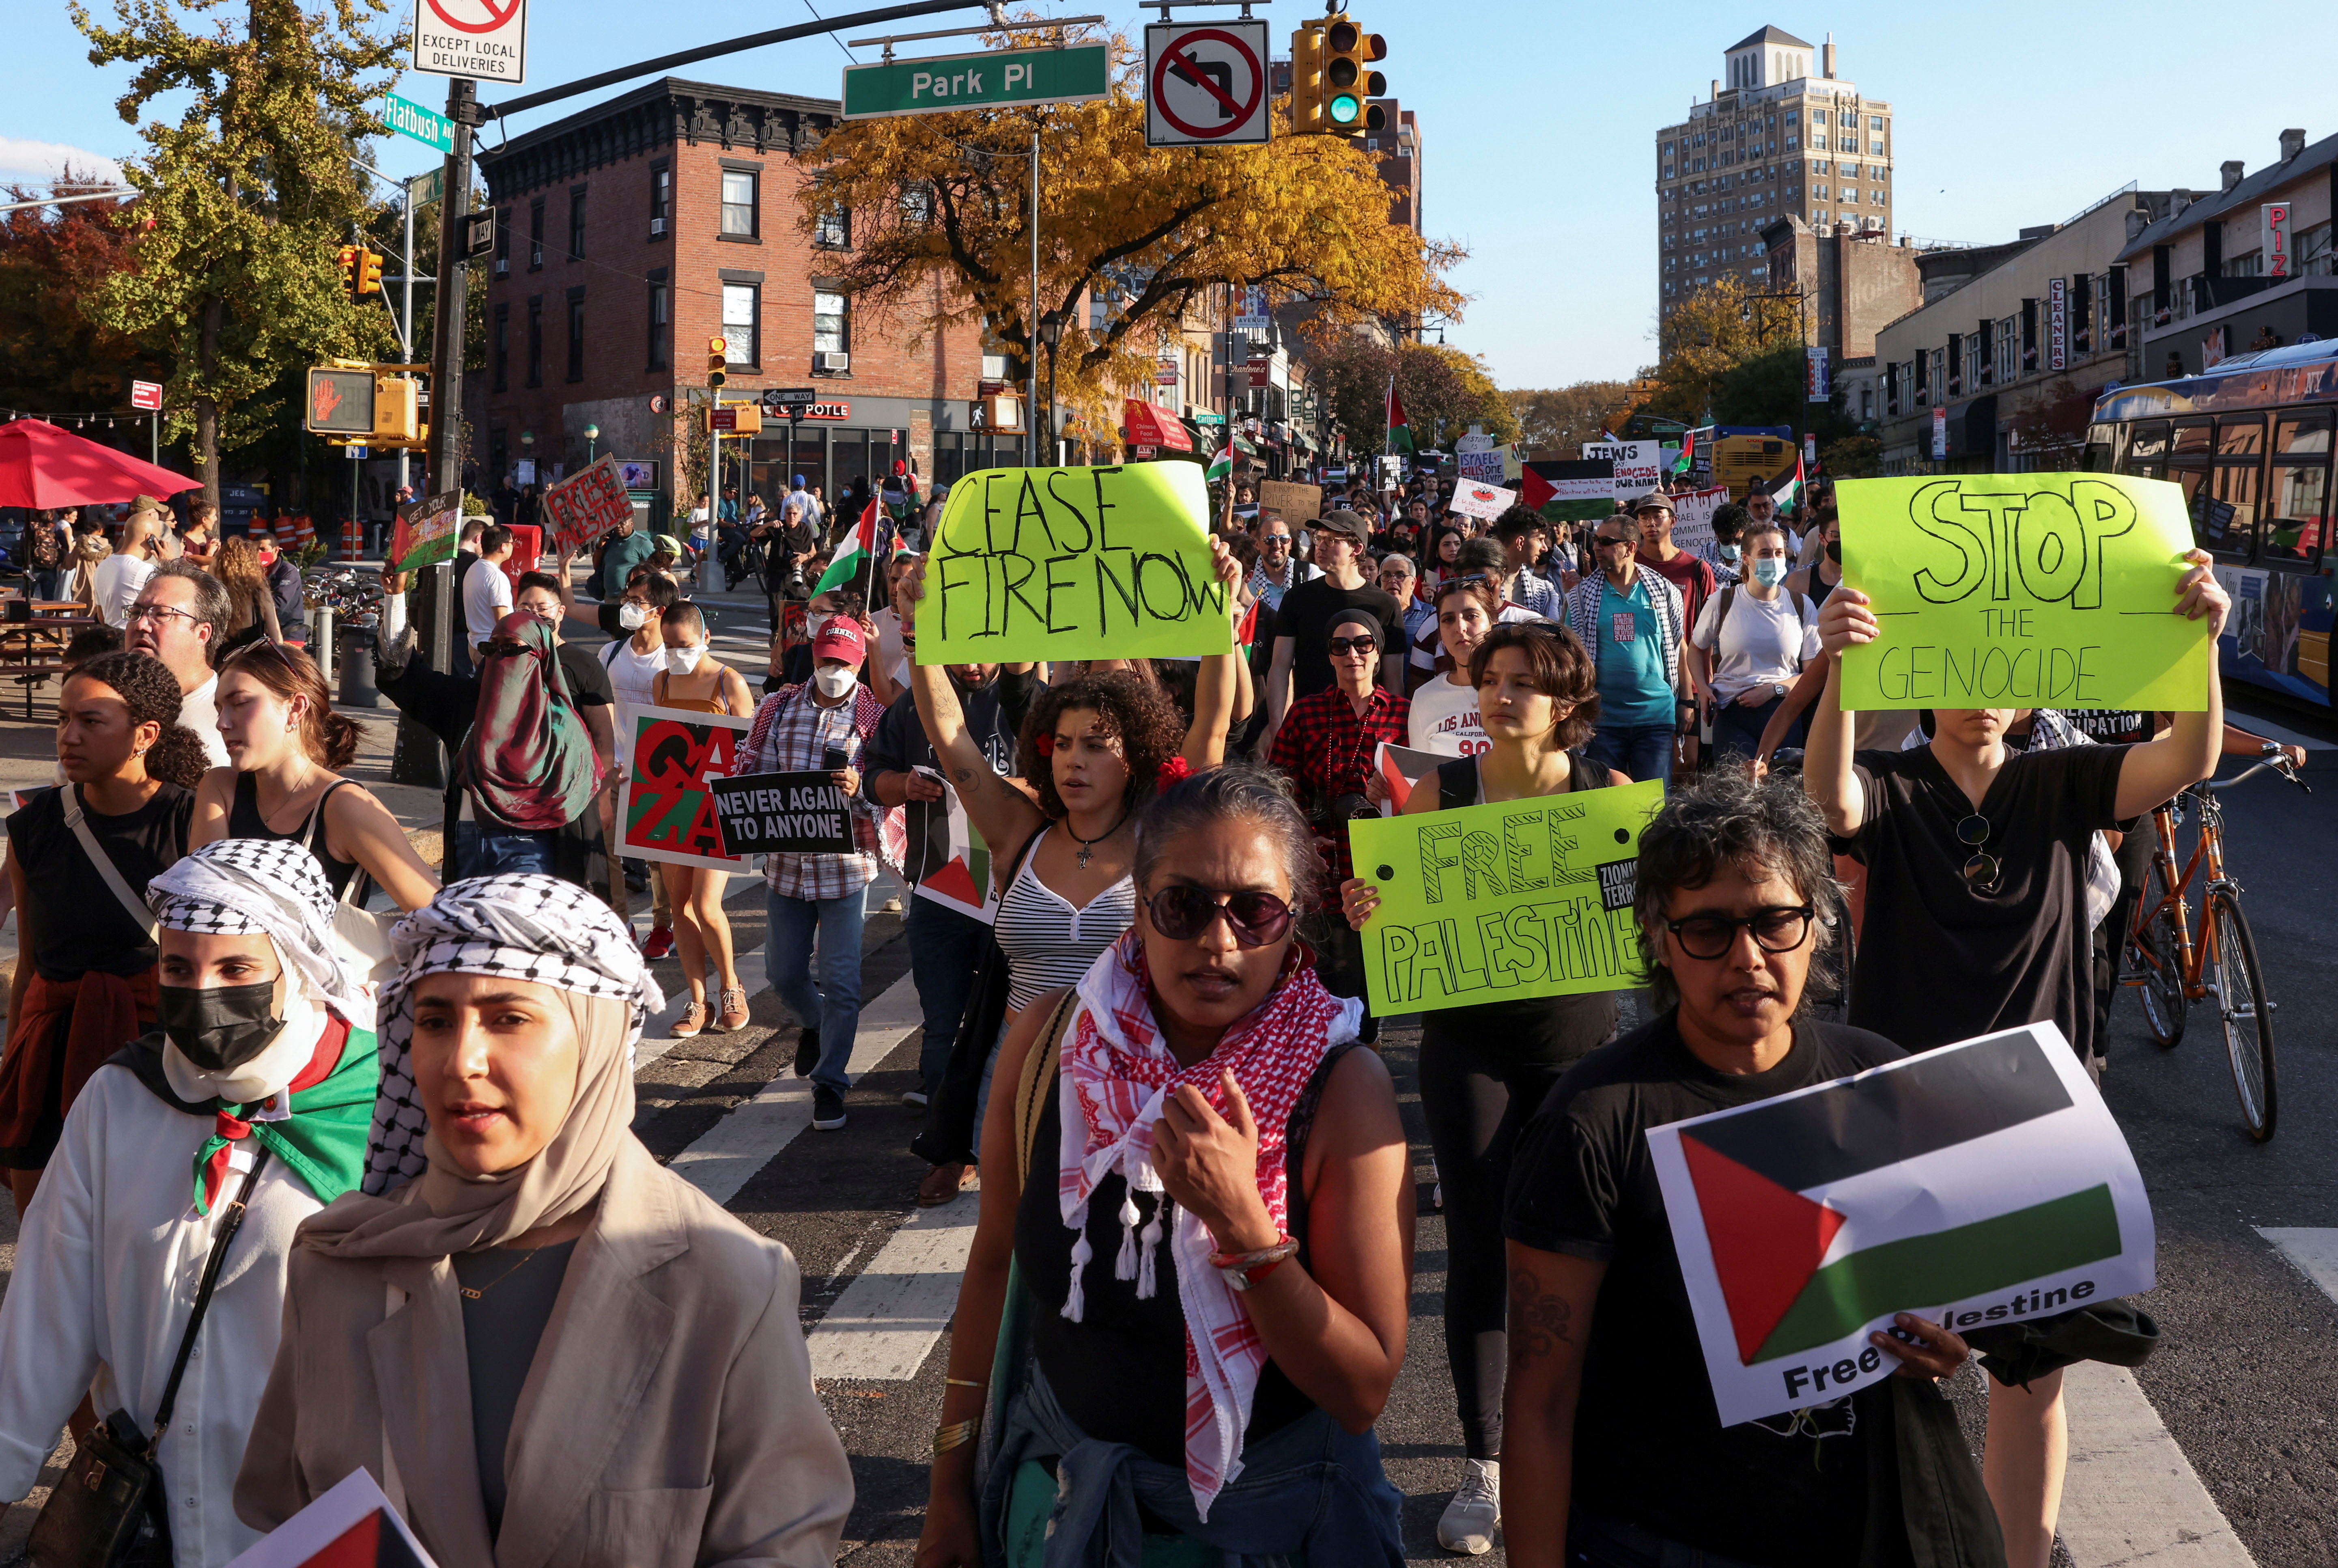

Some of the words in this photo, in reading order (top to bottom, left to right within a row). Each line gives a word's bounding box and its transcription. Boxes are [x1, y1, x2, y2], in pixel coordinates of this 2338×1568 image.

[424, 34, 469, 51] EXCEPT
[476, 42, 515, 58] LOCAL
[433, 53, 504, 73] DELIVERIES
[913, 68, 983, 99] Park
[1005, 63, 1032, 91] Pl
[387, 97, 439, 142] Flatbush
[417, 174, 435, 202] Park
[475, 222, 490, 240] WAY
[2270, 207, 2286, 276] PIZ
[2052, 282, 2063, 367] CLEANERS
[2304, 370, 2325, 394] NY
[780, 405, 848, 416] CPOTLE
[1587, 445, 1638, 461] JEWS
[1461, 465, 1484, 476] KILLS
[1613, 466, 1658, 478] ENOCIDE
[1274, 484, 1294, 493] FROM
[1615, 478, 1633, 489] OUR
[1635, 477, 1659, 487] NAME
[409, 505, 424, 523] GET
[428, 495, 446, 515] YOUR
[1264, 491, 1293, 507] RIVER
[1455, 498, 1483, 508] CRIES
[555, 490, 633, 554] PALESTINE
[942, 467, 1133, 556] CEASE
[1285, 508, 1309, 524] SEA
[1676, 512, 1695, 522] RAEL
[1703, 511, 1710, 520] IS
[1909, 480, 2137, 610] STOP
[2225, 572, 2237, 594] You
[936, 551, 1079, 642] FIRE
[1094, 549, 1224, 638] NOW
[826, 627, 857, 643] CORNELL
[1979, 609, 2034, 638] THE
[1879, 646, 2102, 701] GENOCIDE
[1438, 715, 1457, 732] LOS
[715, 788, 785, 816] NEVER
[789, 785, 849, 811] AGAIN
[730, 817, 758, 840] TO
[765, 814, 843, 839] ANYONE
[1418, 803, 1599, 904] FREE
[1783, 1346, 1881, 1400] Free
[1887, 1279, 2095, 1344] Plestine
